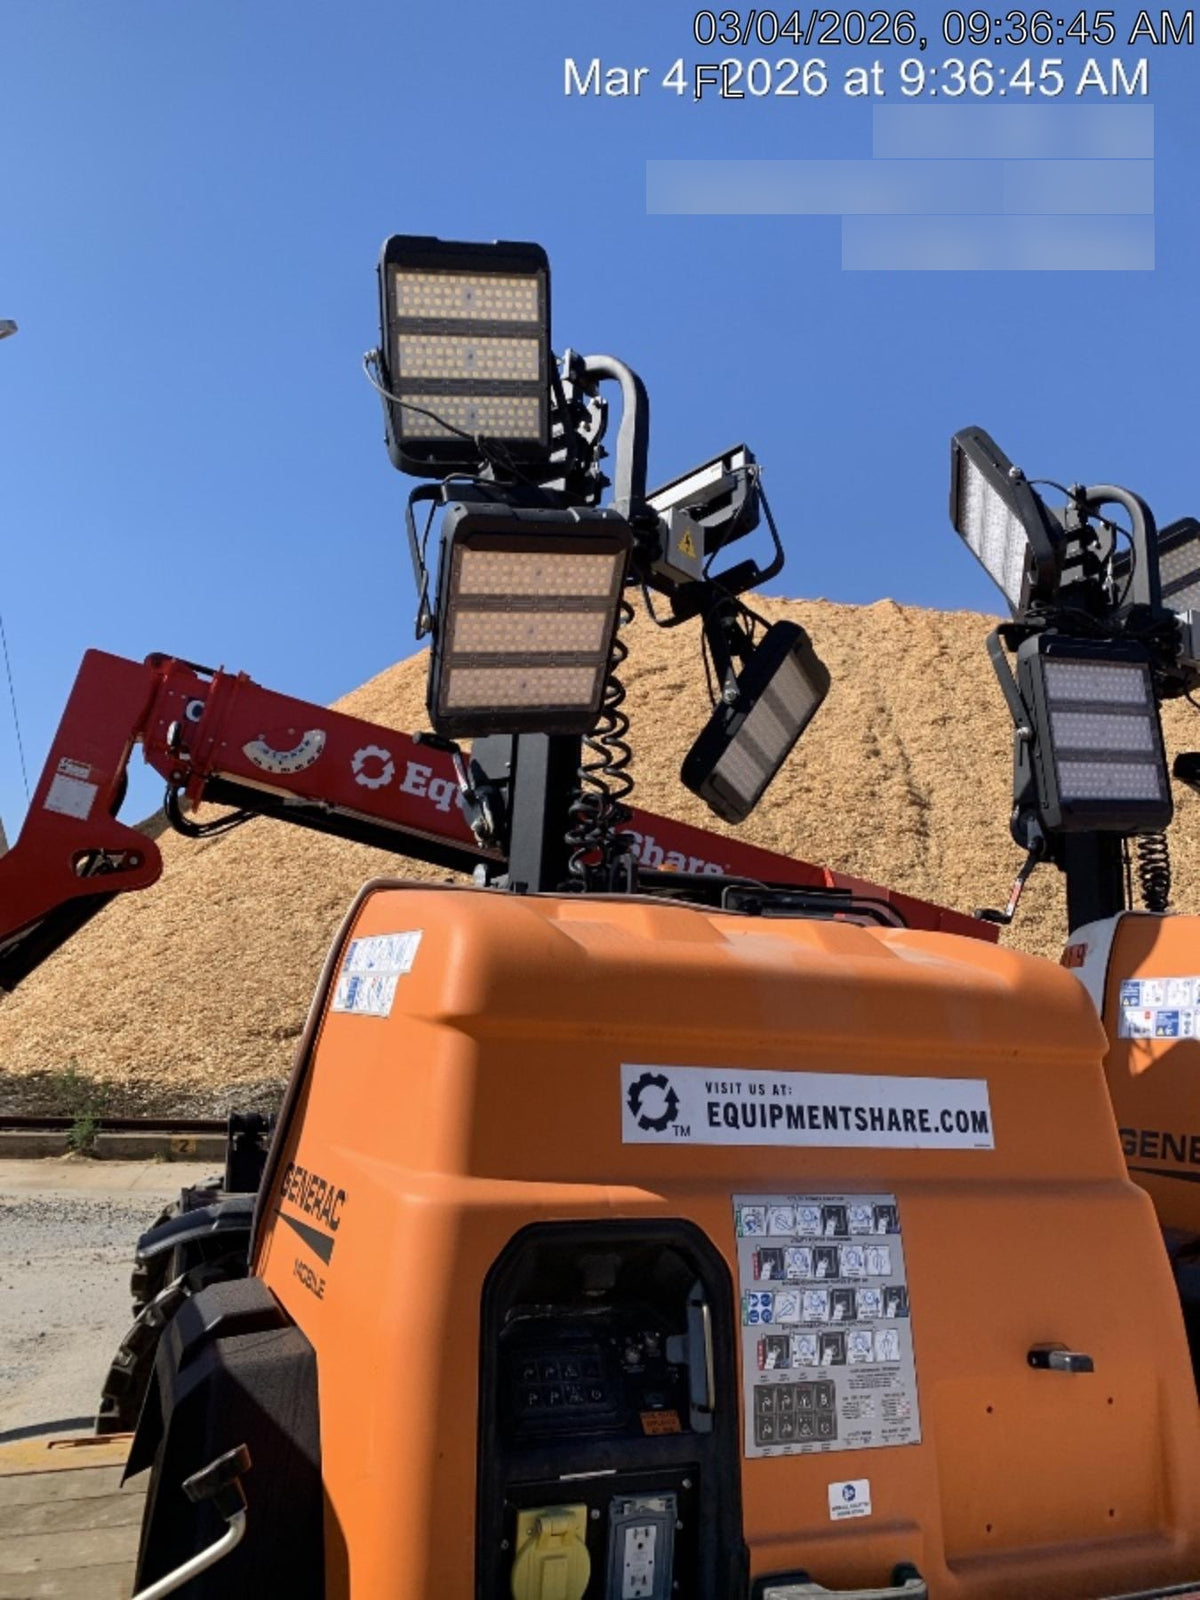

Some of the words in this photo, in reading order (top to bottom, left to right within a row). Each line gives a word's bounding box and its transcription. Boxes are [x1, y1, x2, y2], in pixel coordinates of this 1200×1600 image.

[705, 1081, 742, 1095] VISIT
[749, 1083, 766, 1096] US
[772, 1083, 793, 1096] AT:
[706, 1101, 990, 1134] EQUIPMENTSHARE.COM
[179, 1138, 190, 1153] 2
[280, 1161, 347, 1232] GENERAC
